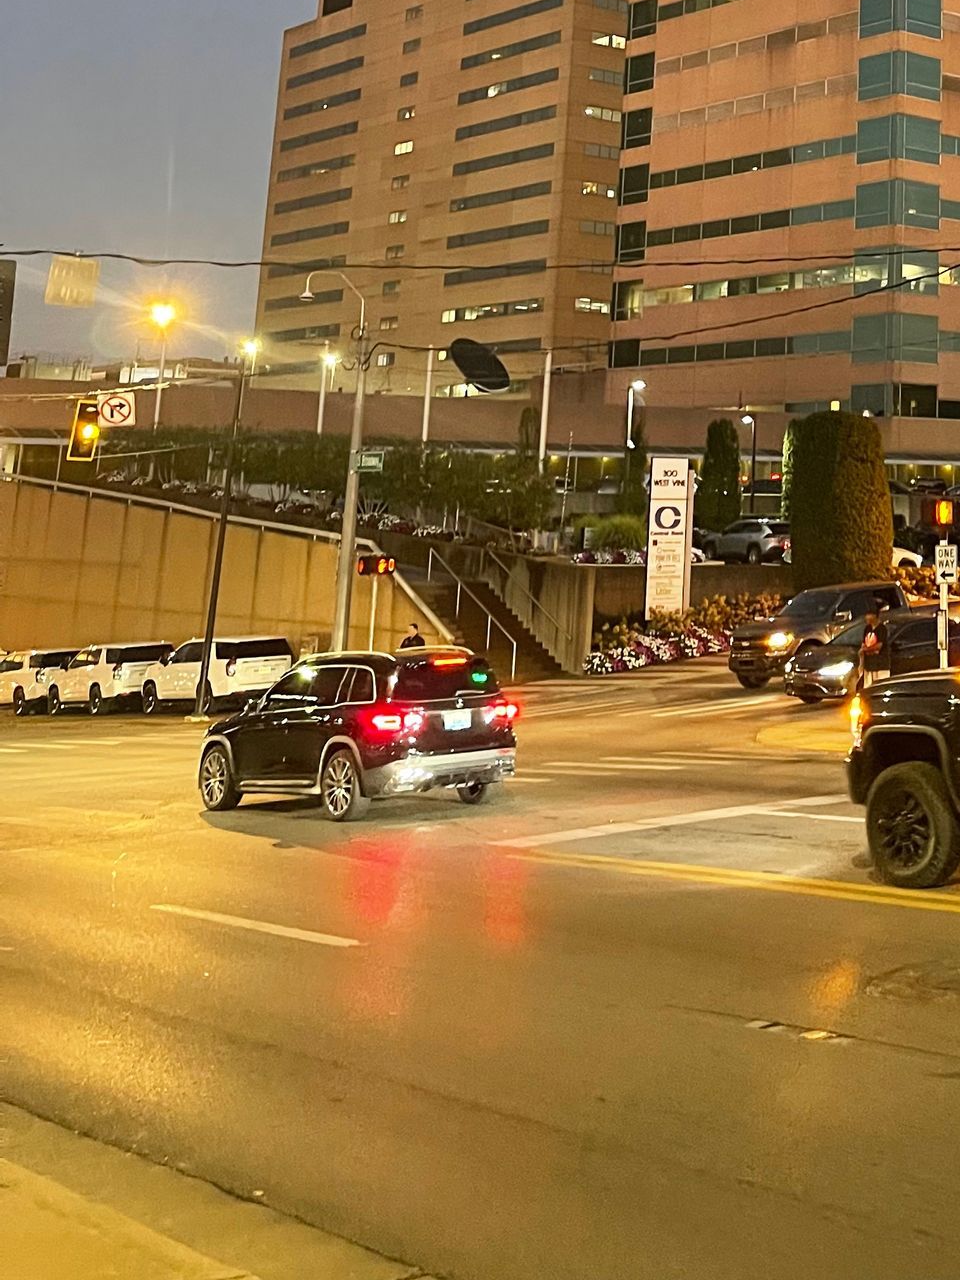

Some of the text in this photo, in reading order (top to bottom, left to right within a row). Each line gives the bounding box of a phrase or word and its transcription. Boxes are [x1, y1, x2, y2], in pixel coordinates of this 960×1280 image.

[663, 469, 678, 478] 300
[654, 479, 686, 487] WEST VINE
[938, 548, 955, 558] ONE
[938, 559, 955, 568] WAY
